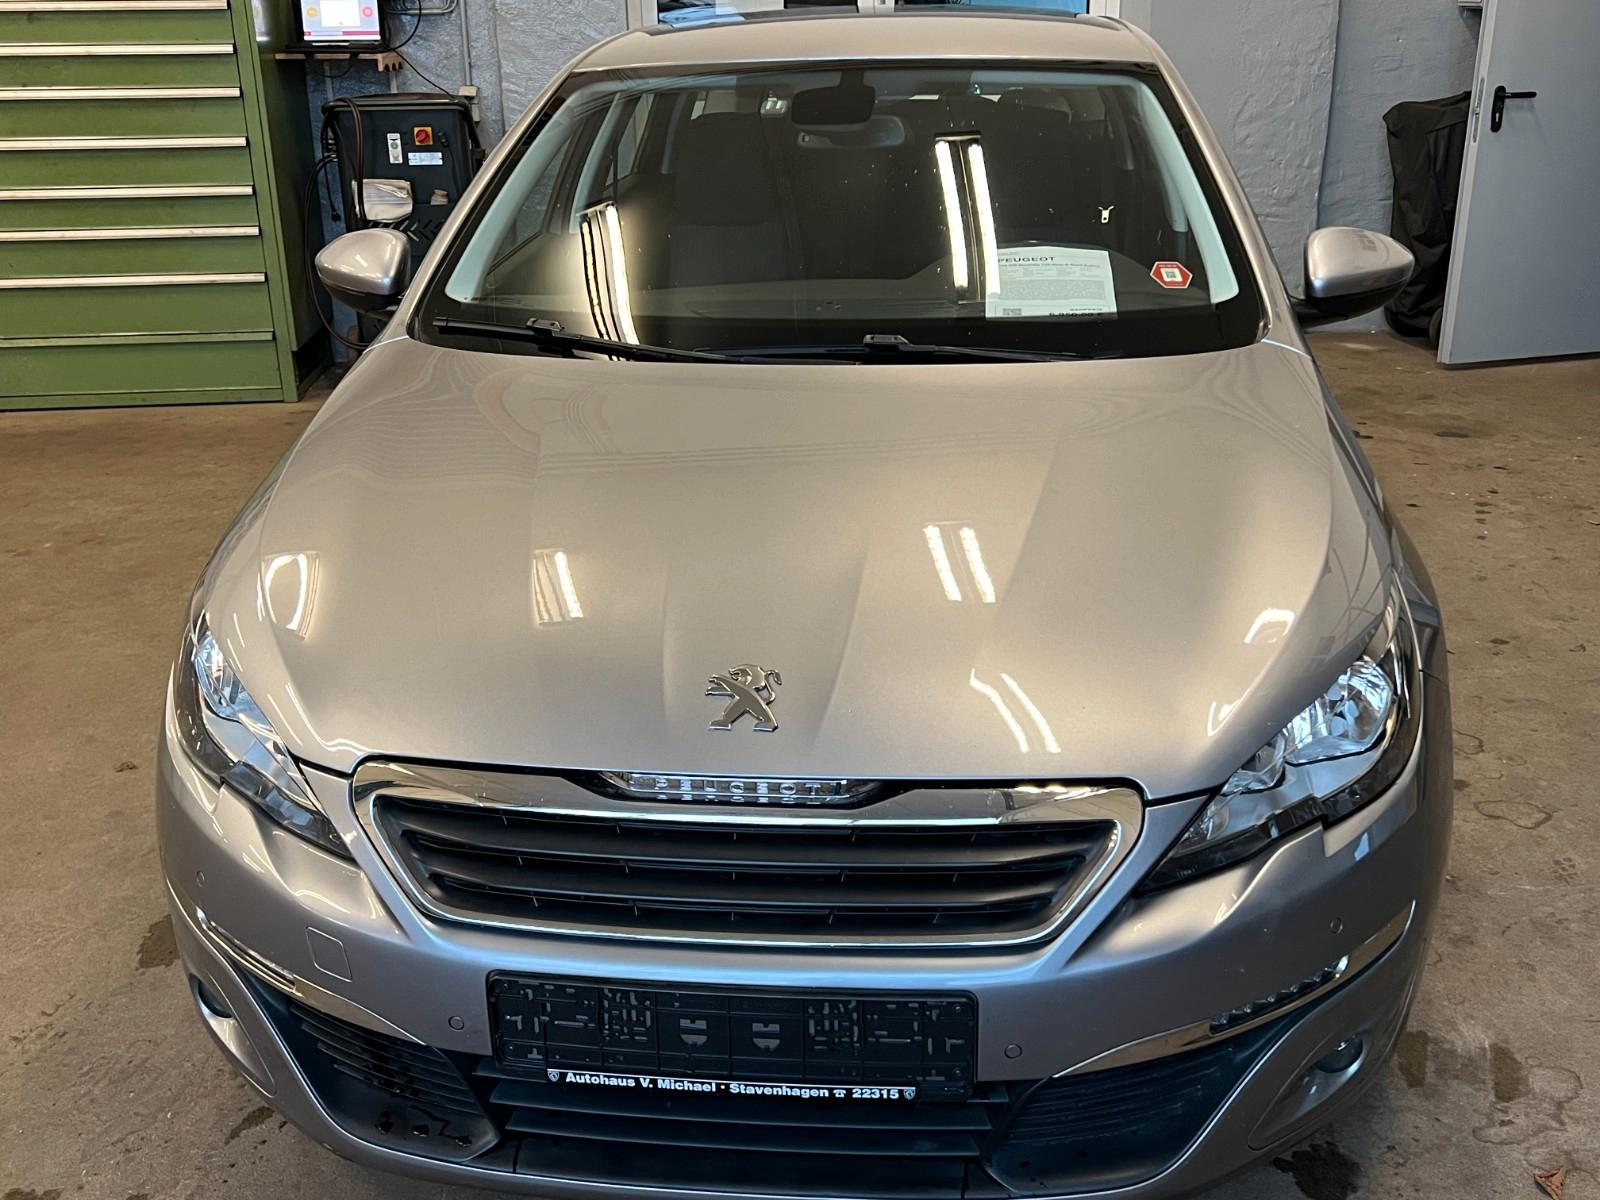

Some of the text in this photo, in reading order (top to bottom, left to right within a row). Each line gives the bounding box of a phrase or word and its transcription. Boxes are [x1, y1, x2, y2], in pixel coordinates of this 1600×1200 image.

[565, 1072, 899, 1099] Autohaus V. Michael Stavenhagen 22315
